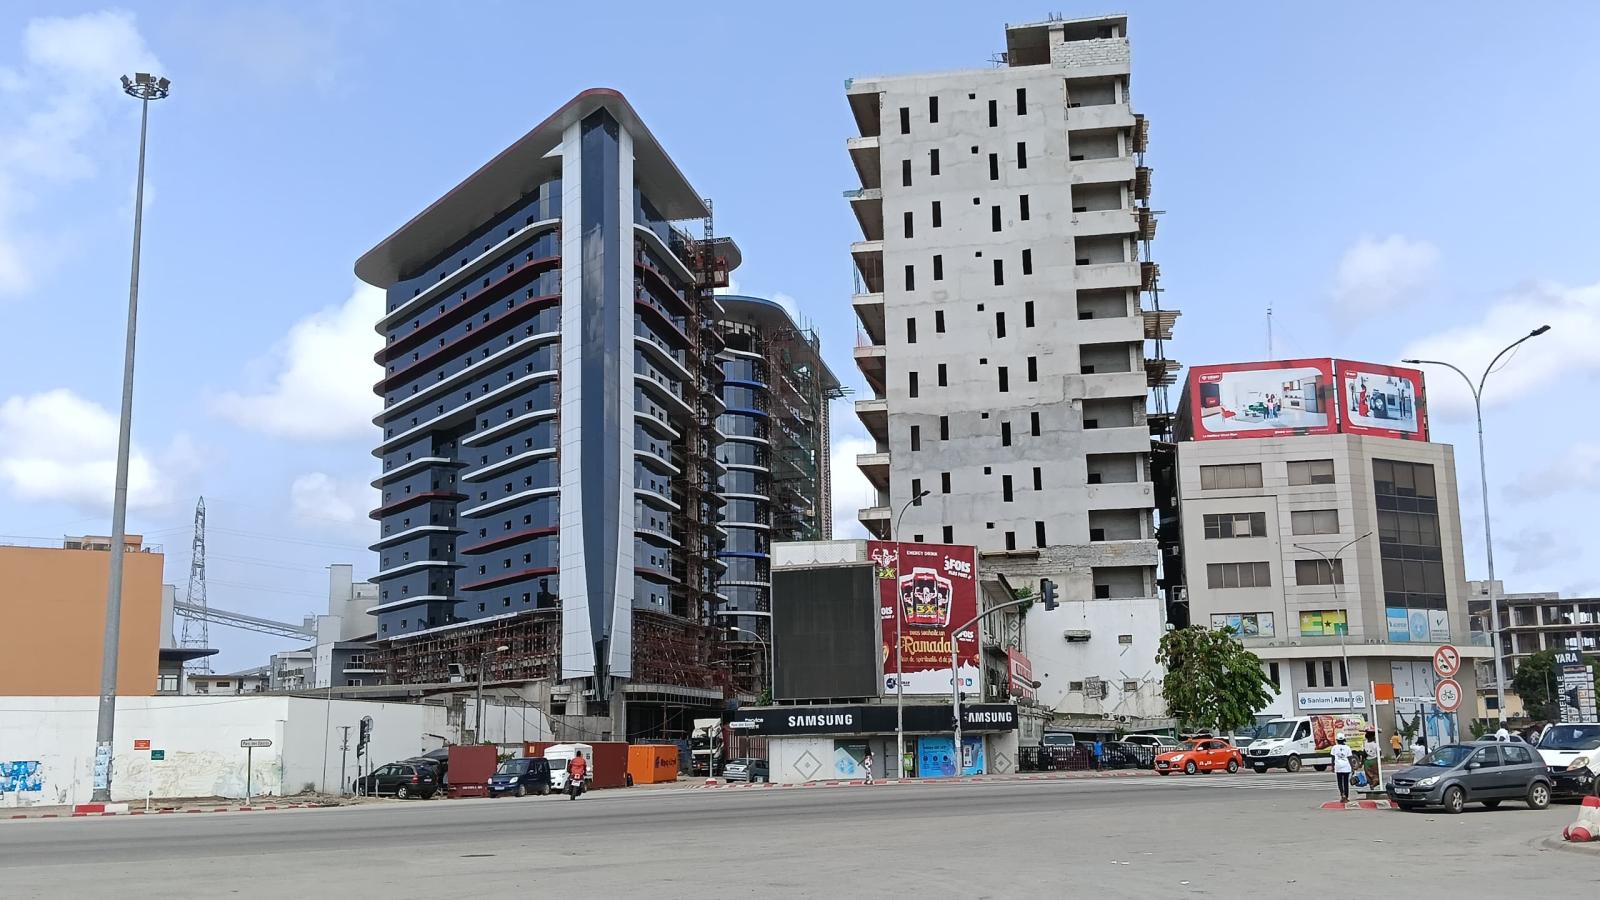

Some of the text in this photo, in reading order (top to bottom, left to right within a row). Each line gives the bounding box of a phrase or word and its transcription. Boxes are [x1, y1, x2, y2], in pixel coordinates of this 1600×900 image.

[1555, 653, 1578, 663] YARA
[1557, 676, 1568, 722] MMEUBLE
[788, 714, 853, 727] SAMSUNG
